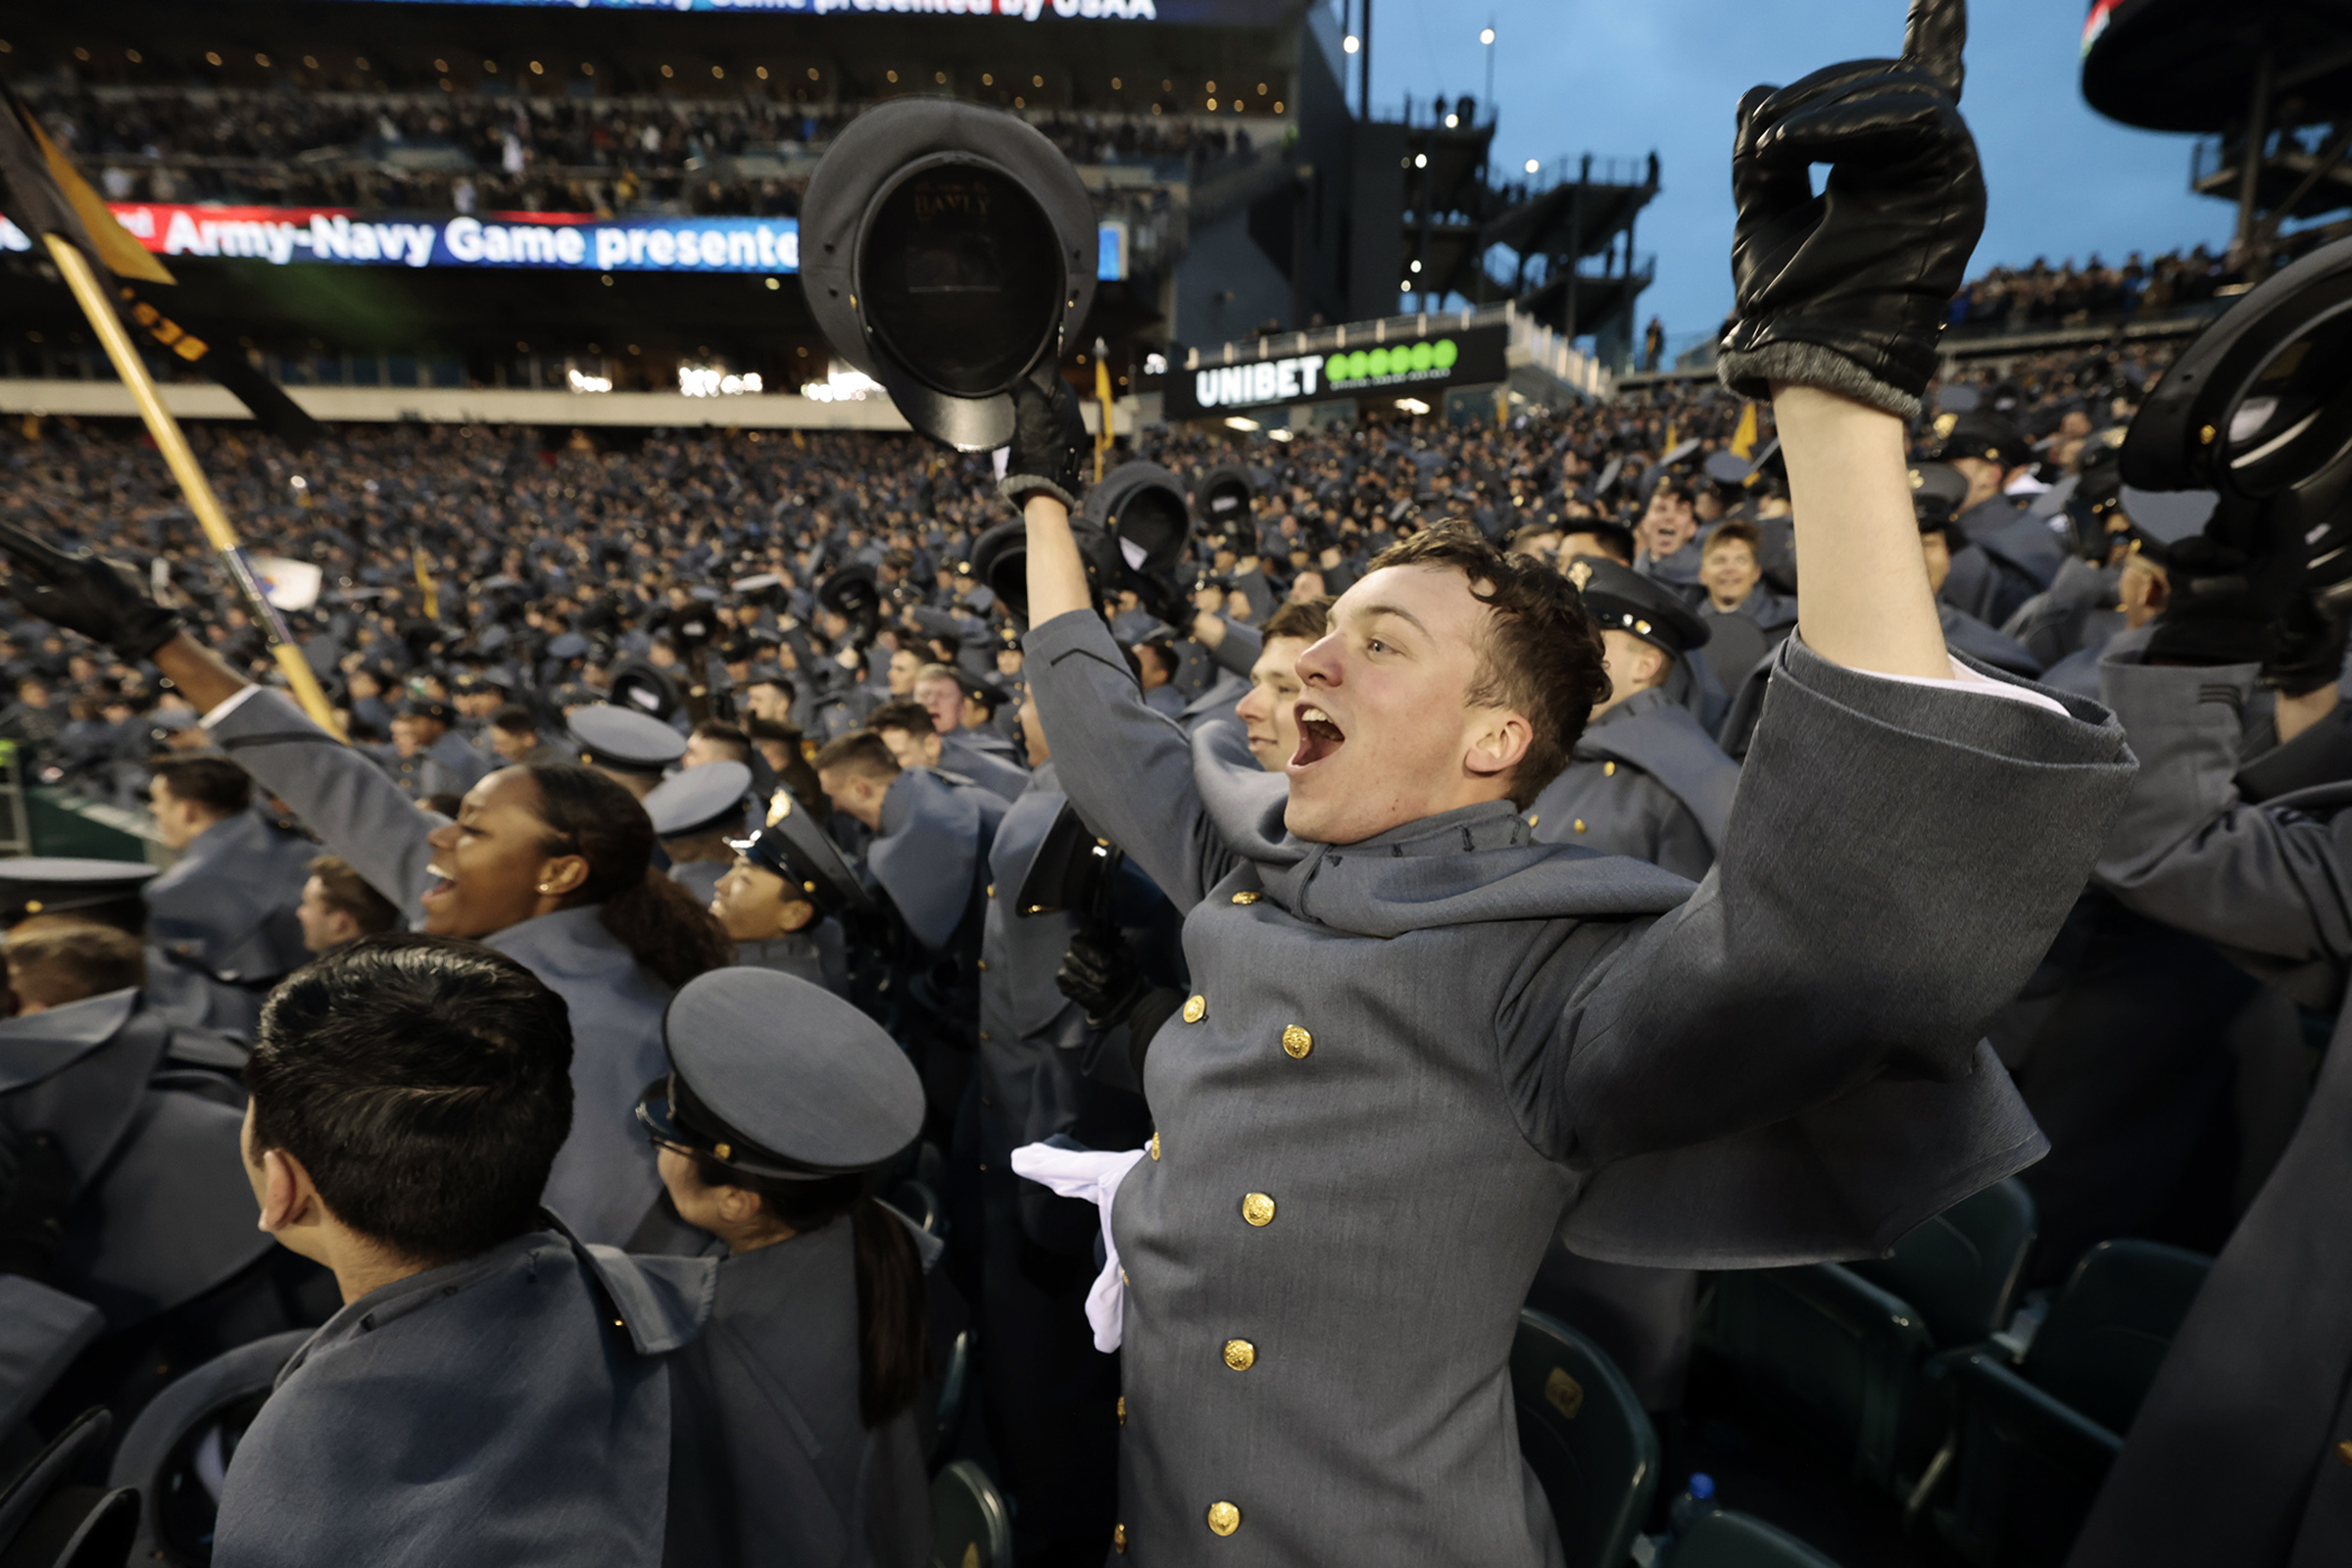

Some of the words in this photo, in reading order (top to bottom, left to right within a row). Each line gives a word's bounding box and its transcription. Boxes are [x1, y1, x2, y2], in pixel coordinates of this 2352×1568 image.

[164, 209, 436, 268] Army-Navy
[444, 216, 587, 265] Game
[1196, 355, 1324, 408] UNIBET
